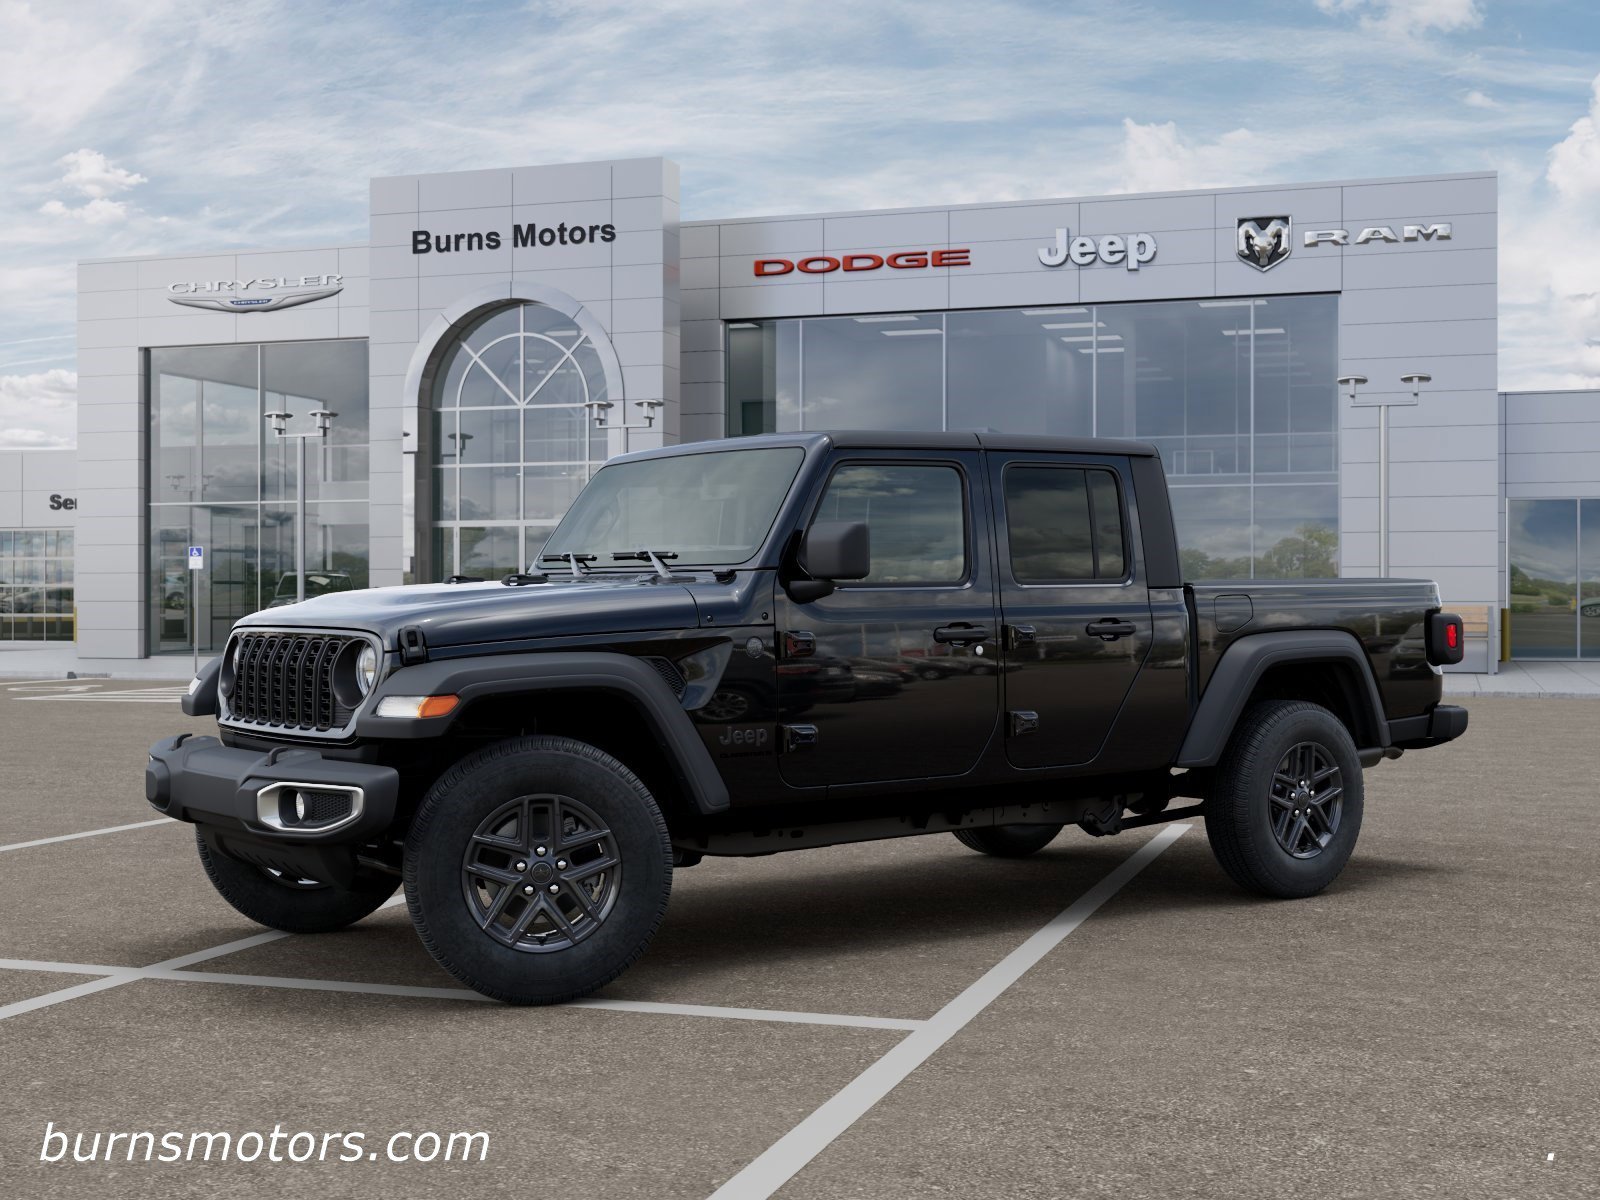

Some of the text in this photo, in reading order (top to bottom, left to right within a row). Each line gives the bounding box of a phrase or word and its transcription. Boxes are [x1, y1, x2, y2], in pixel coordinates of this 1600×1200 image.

[412, 222, 616, 254] Burns Motors
[1304, 223, 1452, 248] RAM
[1038, 227, 1157, 271] Jeep
[754, 249, 971, 277] DODGE
[168, 274, 343, 293] CHRYSLER
[719, 726, 768, 747] Jeep
